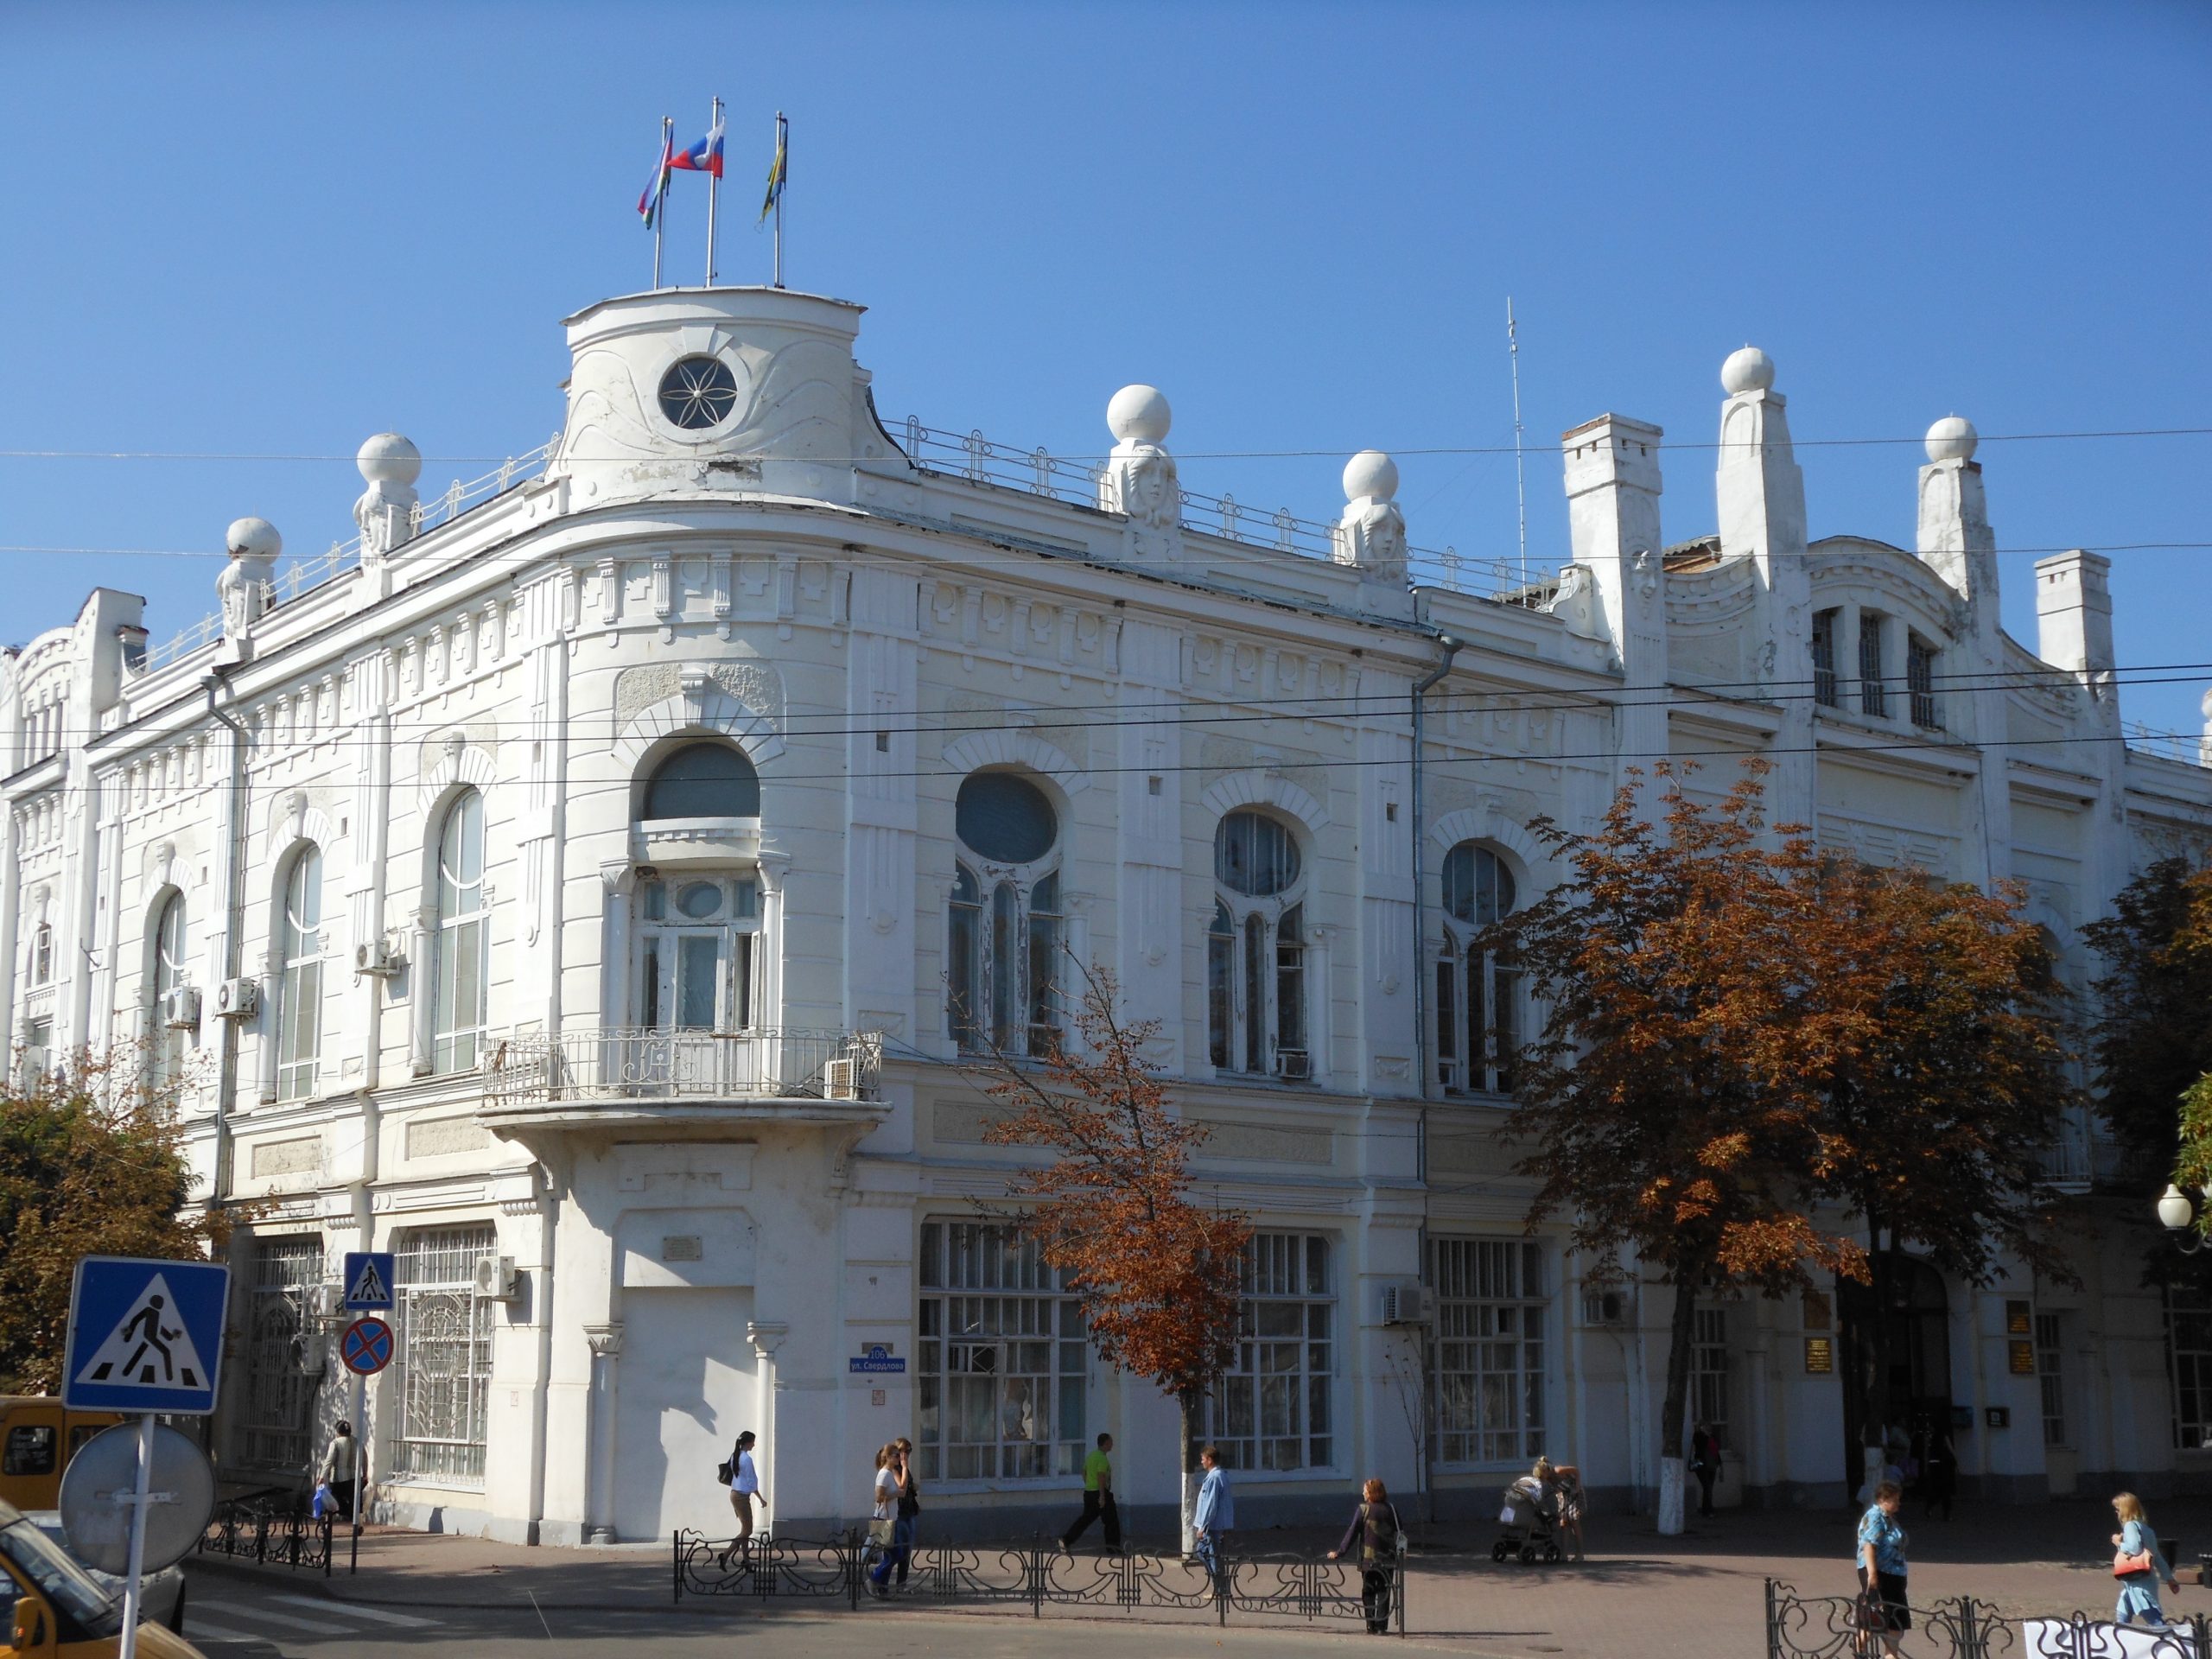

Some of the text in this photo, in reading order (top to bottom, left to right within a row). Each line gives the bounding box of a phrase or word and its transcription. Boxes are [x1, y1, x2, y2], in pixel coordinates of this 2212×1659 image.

[871, 1350, 886, 1359] 106
[851, 1362, 904, 1371] ул. Свердлова
